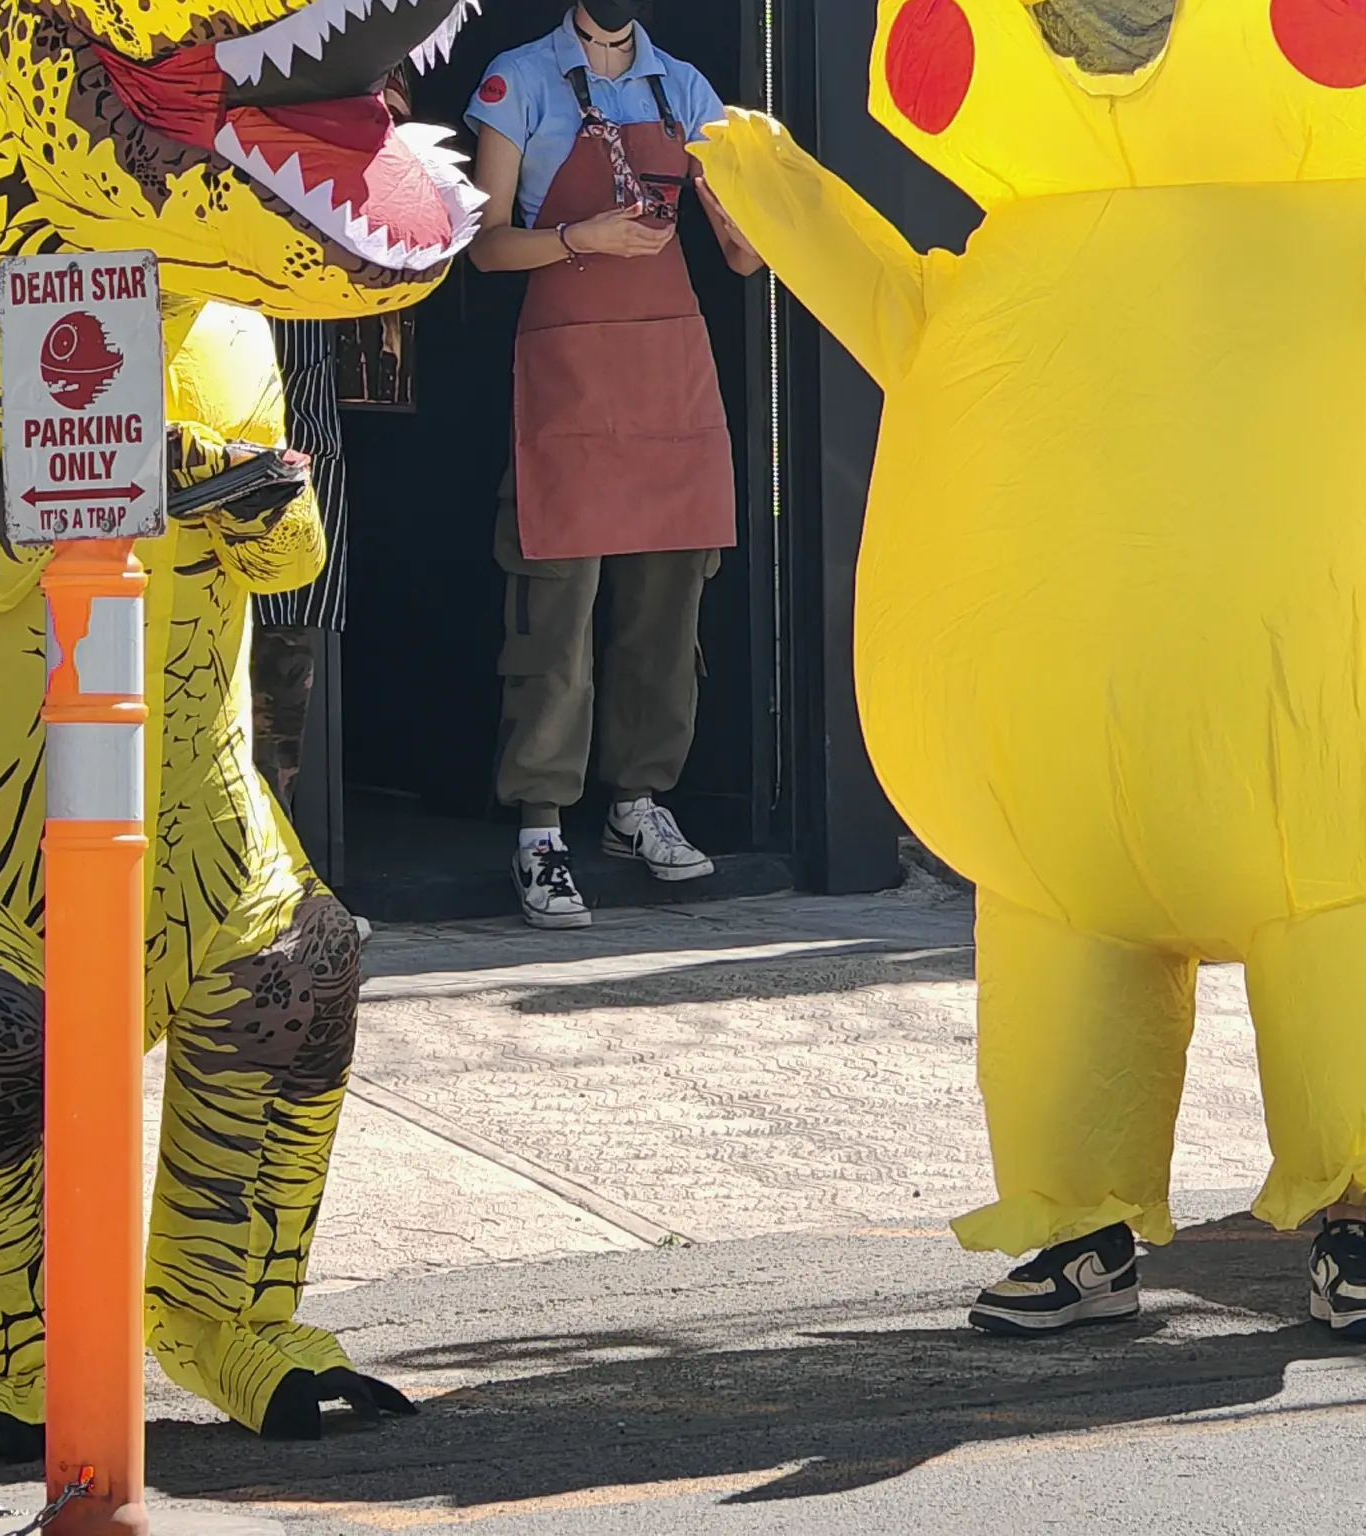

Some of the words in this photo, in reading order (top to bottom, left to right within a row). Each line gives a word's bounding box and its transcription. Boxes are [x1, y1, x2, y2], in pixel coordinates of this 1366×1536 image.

[10, 268, 84, 306] DEATH
[91, 265, 147, 301] STAR
[23, 413, 143, 448] PARKING
[49, 450, 117, 482] ONLY
[40, 508, 68, 531] IT'S
[72, 507, 84, 529] A
[87, 506, 127, 529] TRAP
